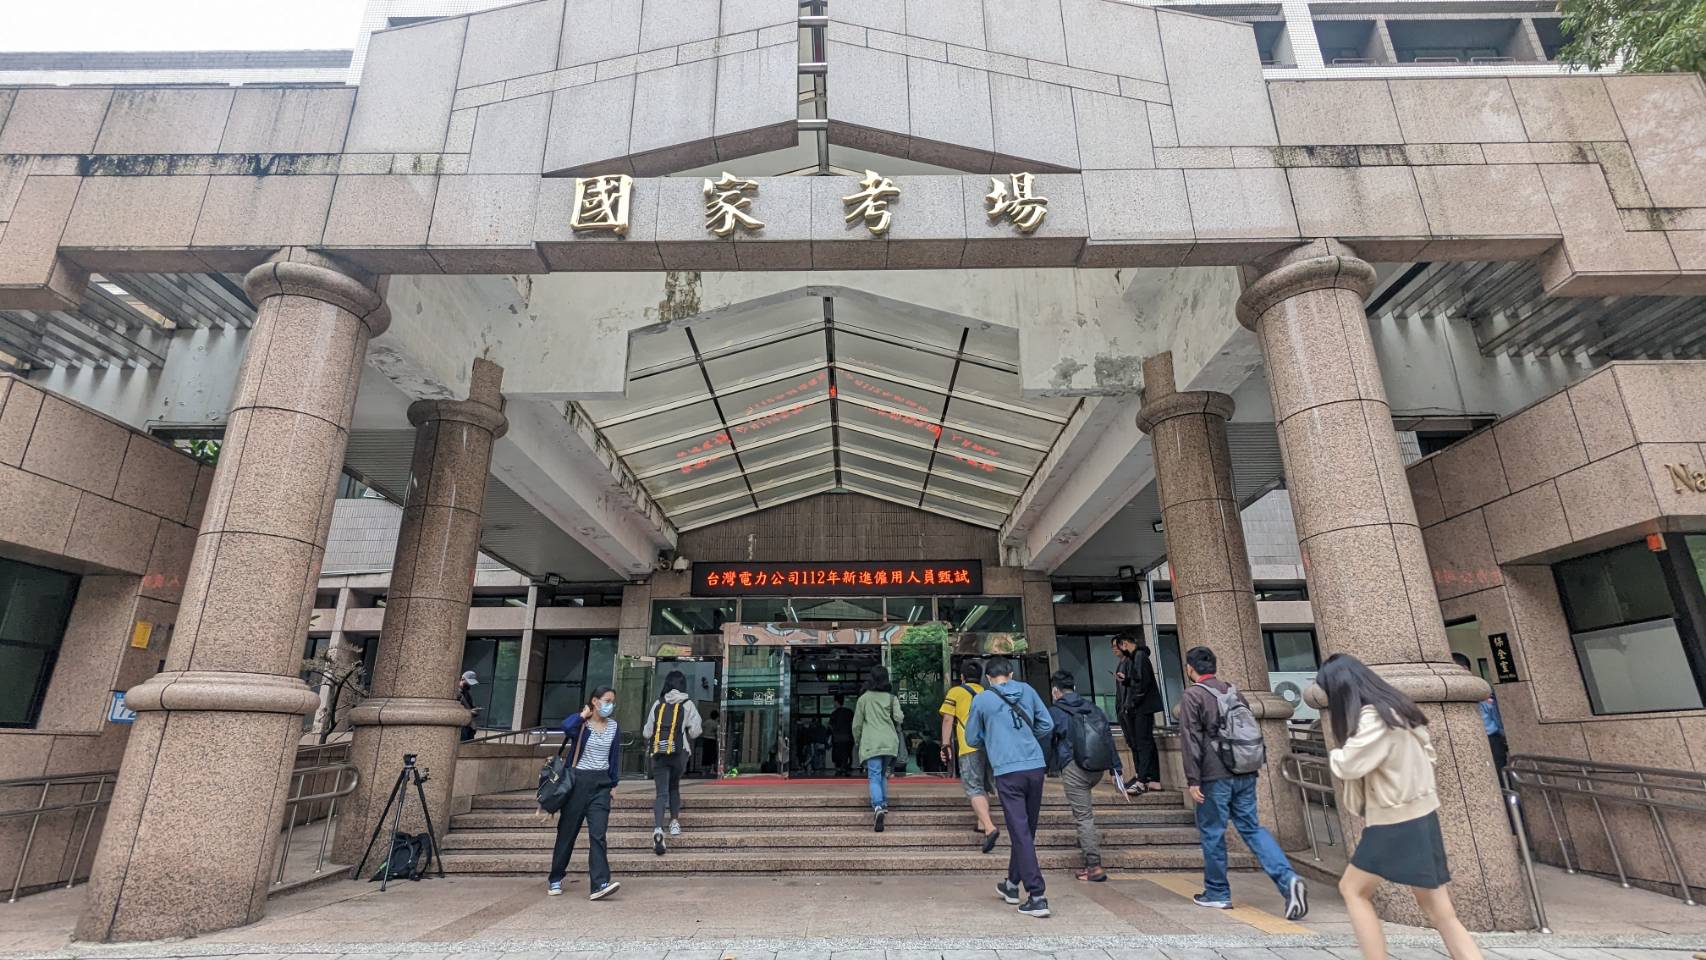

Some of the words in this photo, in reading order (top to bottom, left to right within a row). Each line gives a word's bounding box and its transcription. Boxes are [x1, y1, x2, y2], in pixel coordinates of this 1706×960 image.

[570, 170, 1049, 237] 國家考場
[1664, 463, 1706, 494] Na
[707, 569, 970, 587] 台灣電力公司112年新進僱用人員甄試
[1494, 637, 1509, 673] 保全室
